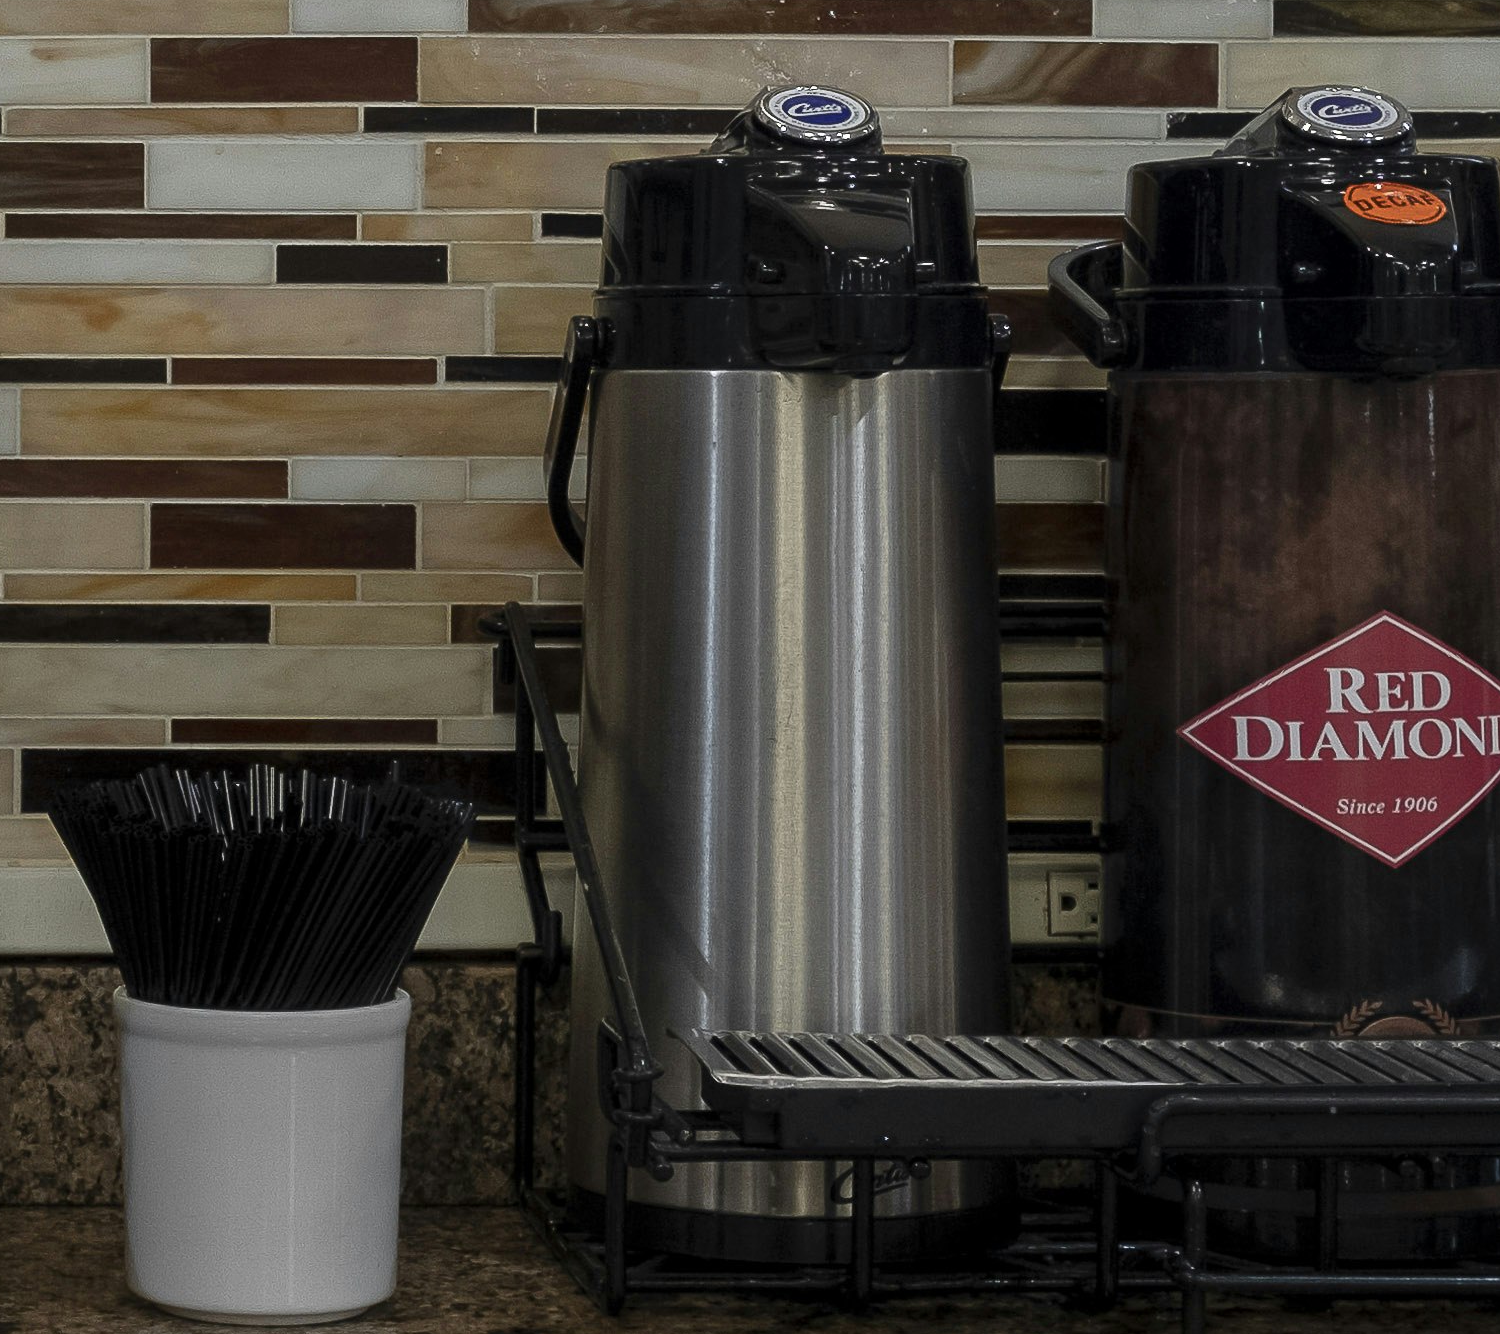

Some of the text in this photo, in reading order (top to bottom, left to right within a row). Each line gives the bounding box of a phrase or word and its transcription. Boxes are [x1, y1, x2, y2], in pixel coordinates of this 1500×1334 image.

[1352, 191, 1436, 212] DECAF
[1324, 667, 1452, 714] RED
[1337, 797, 1438, 816] Since 1906
